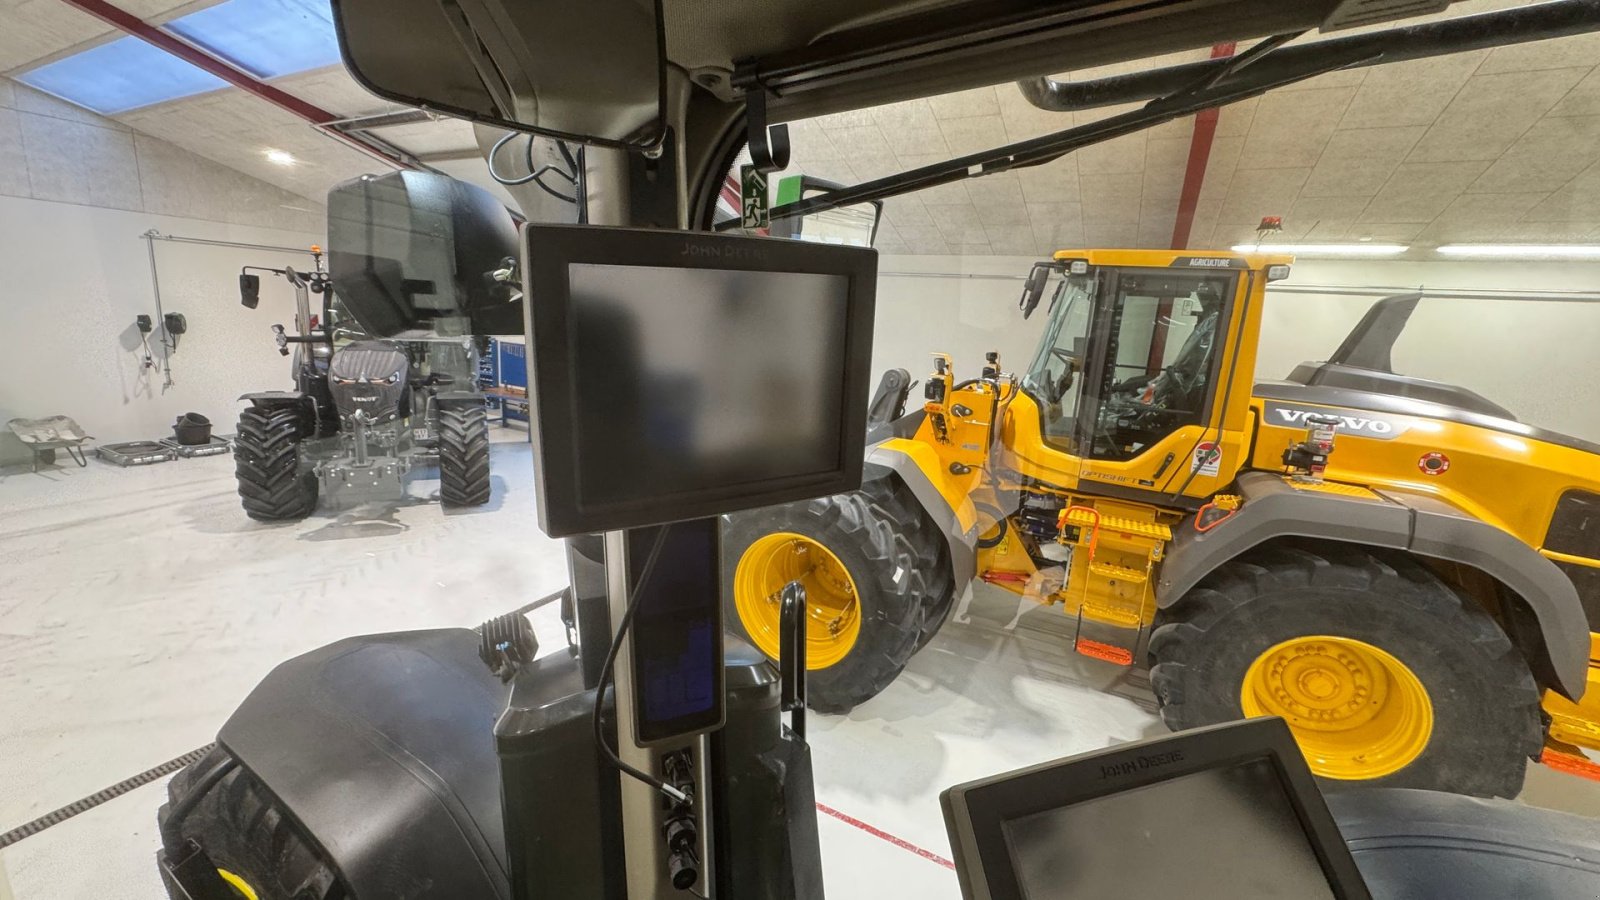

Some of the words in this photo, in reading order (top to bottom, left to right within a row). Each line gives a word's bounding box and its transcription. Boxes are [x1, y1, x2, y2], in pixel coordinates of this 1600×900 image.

[680, 242, 720, 257] JOHN
[1189, 258, 1231, 267] AGRICULTURE
[1098, 761, 1137, 779] JOHN
[1137, 750, 1184, 769] DEERE
